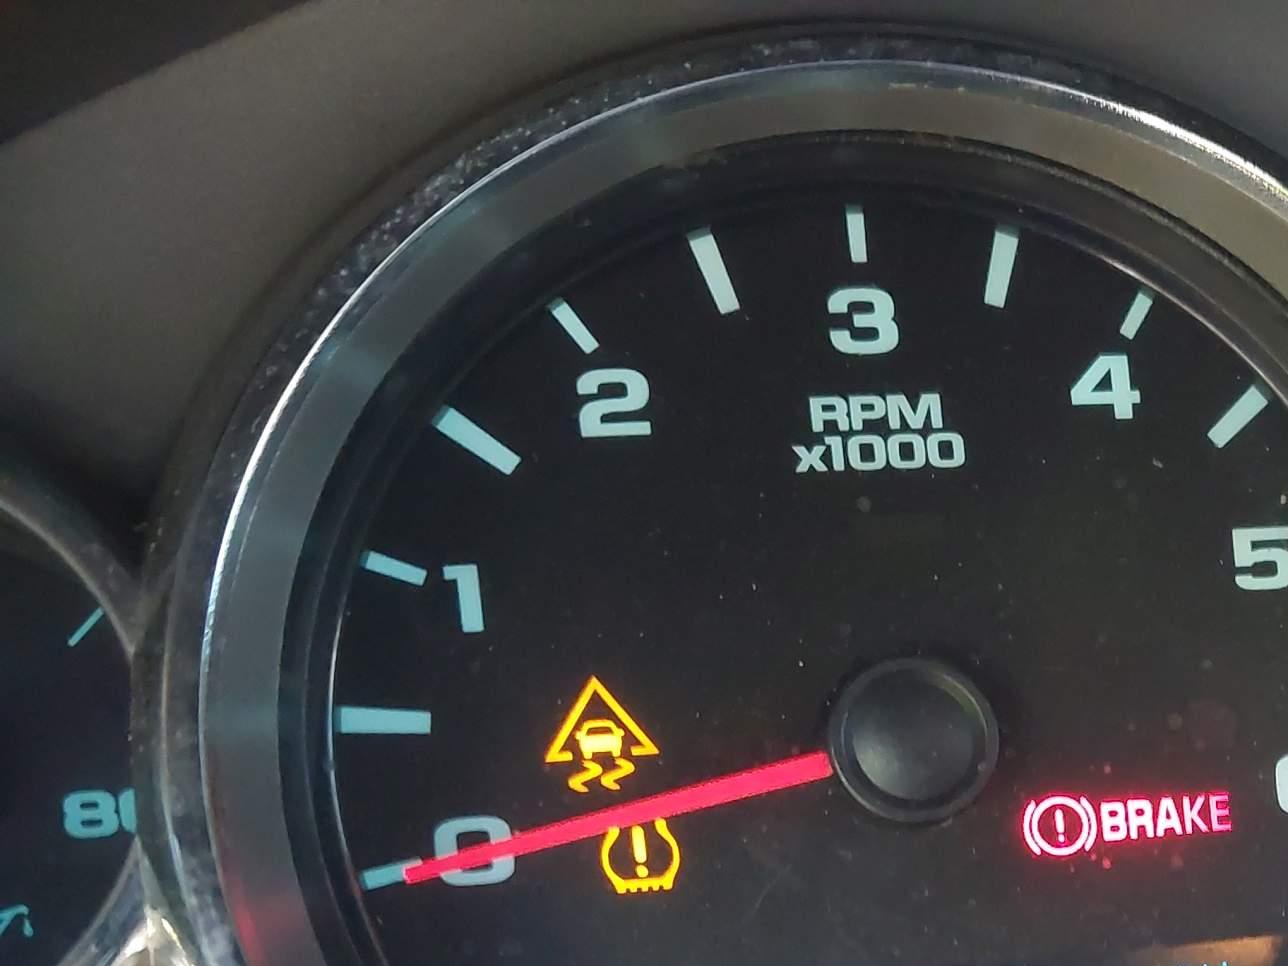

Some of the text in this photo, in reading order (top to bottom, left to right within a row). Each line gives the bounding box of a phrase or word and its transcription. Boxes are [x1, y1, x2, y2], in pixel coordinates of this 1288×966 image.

[826, 286, 899, 355] 3
[576, 367, 652, 438] 2
[808, 393, 943, 433] RPM
[1070, 353, 1140, 420] 4
[792, 432, 966, 473] x1000
[442, 563, 485, 633] 1
[433, 815, 516, 887] 0
[1101, 792, 1232, 842] BRAKE
